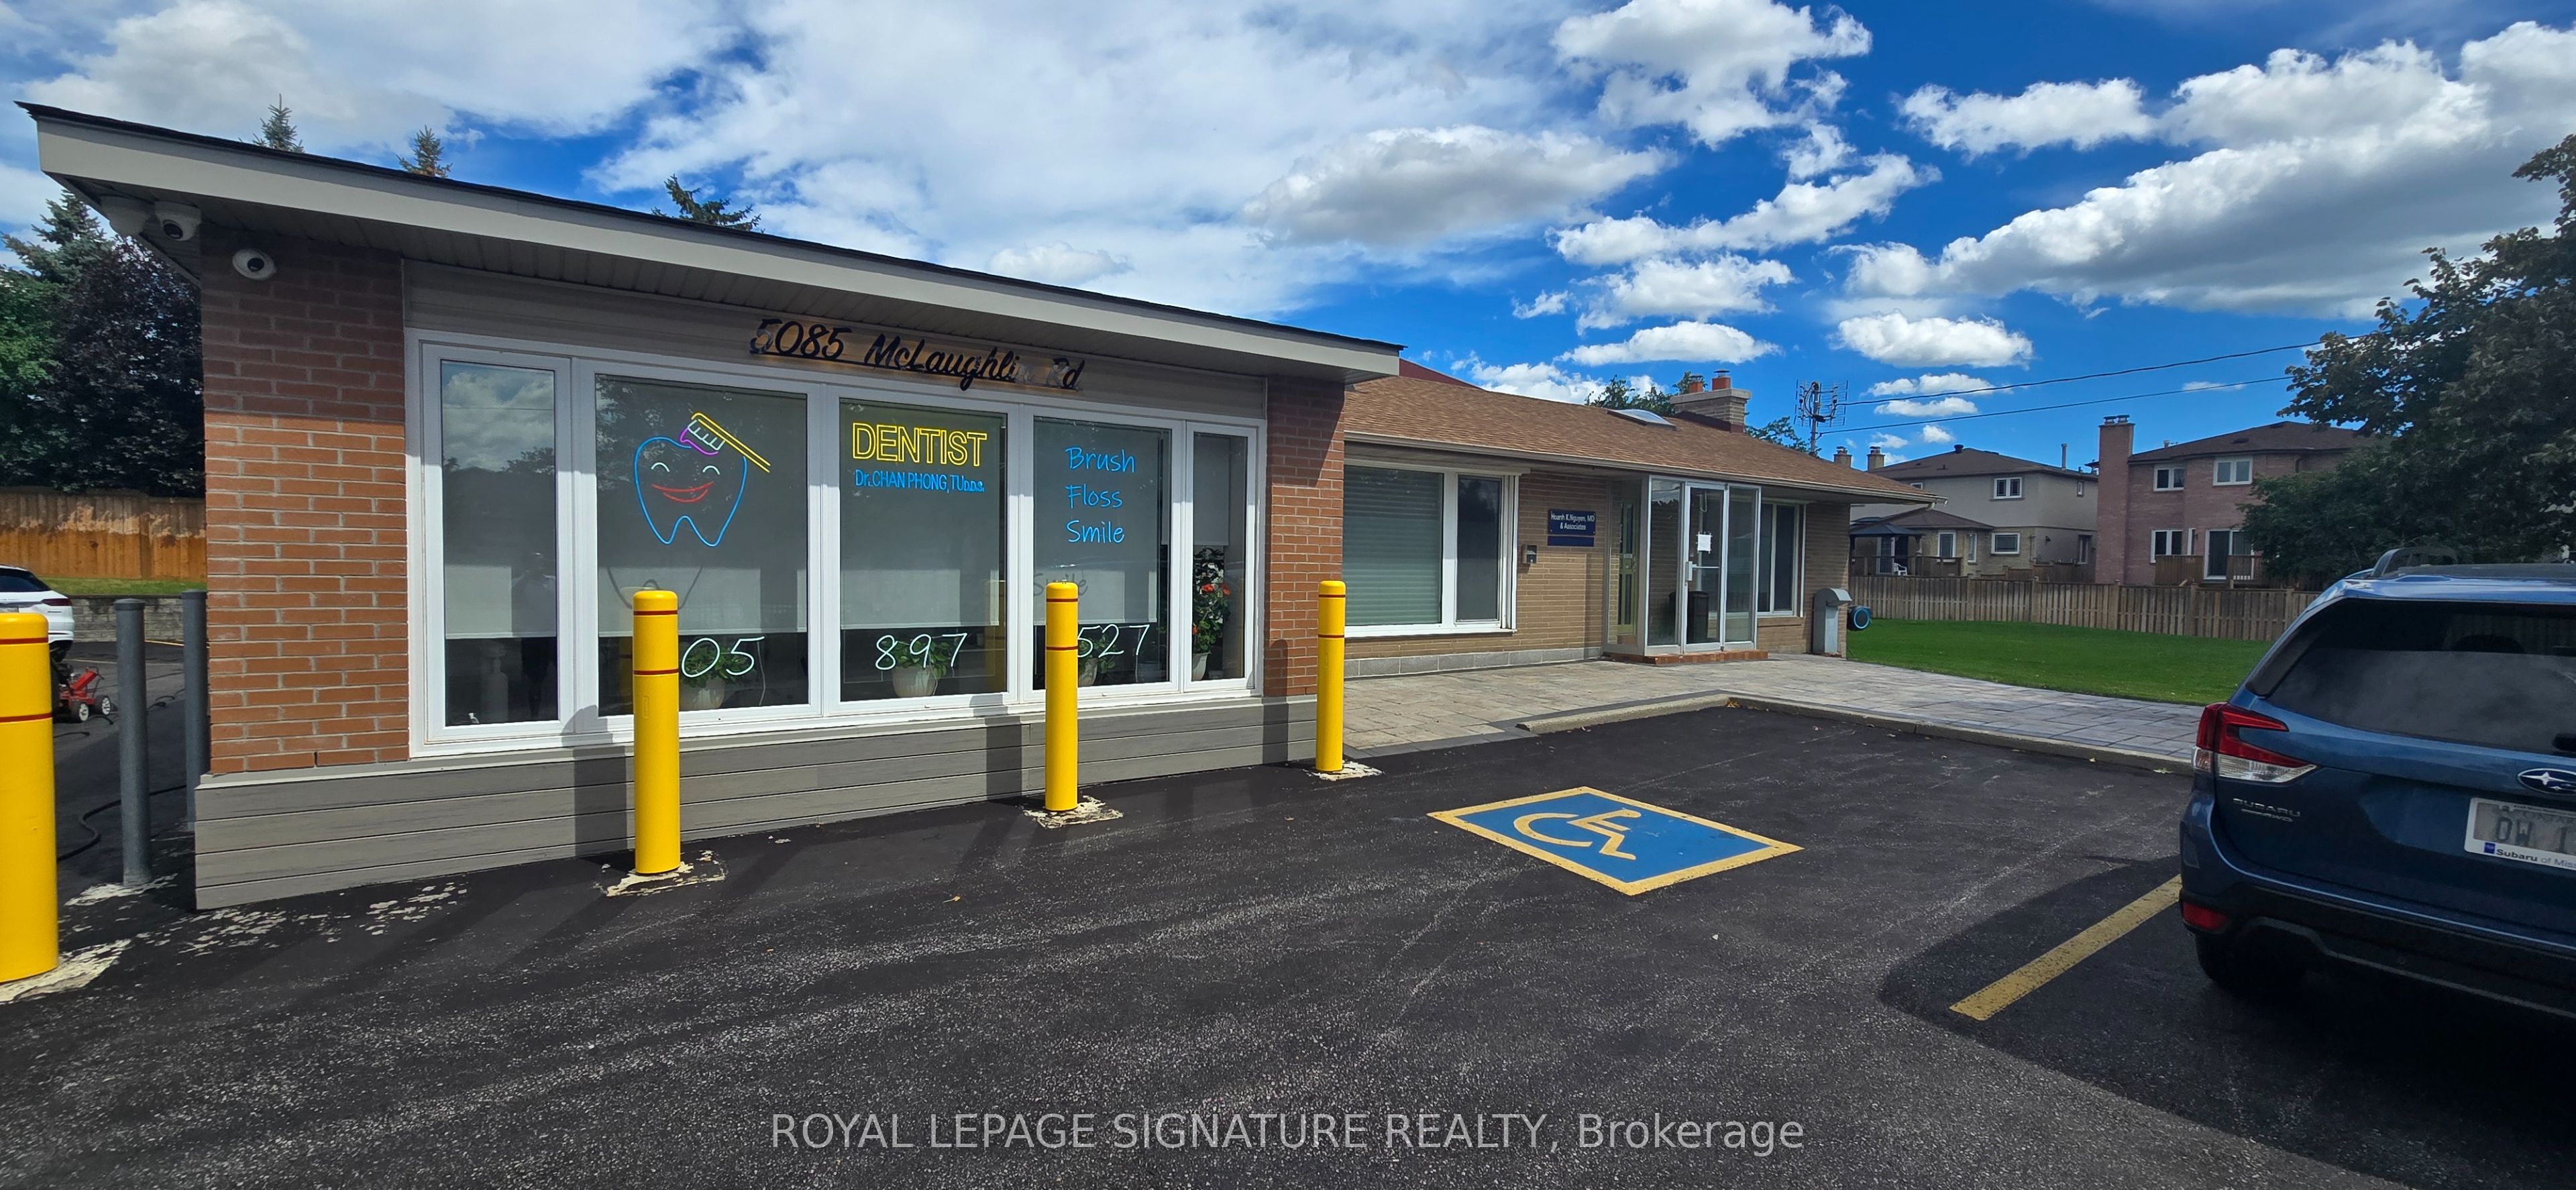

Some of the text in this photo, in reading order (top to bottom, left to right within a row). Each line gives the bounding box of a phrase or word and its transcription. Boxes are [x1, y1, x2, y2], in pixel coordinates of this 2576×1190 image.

[749, 319, 853, 360] 5085
[852, 423, 988, 467] DENTIST
[1065, 447, 1136, 474] Brush
[1065, 484, 1123, 508] Floss
[1065, 519, 1125, 543] Smile
[874, 632, 969, 670] 897
[2233, 798, 2301, 817] SUBARU
[2496, 849, 2538, 862] Subaru
